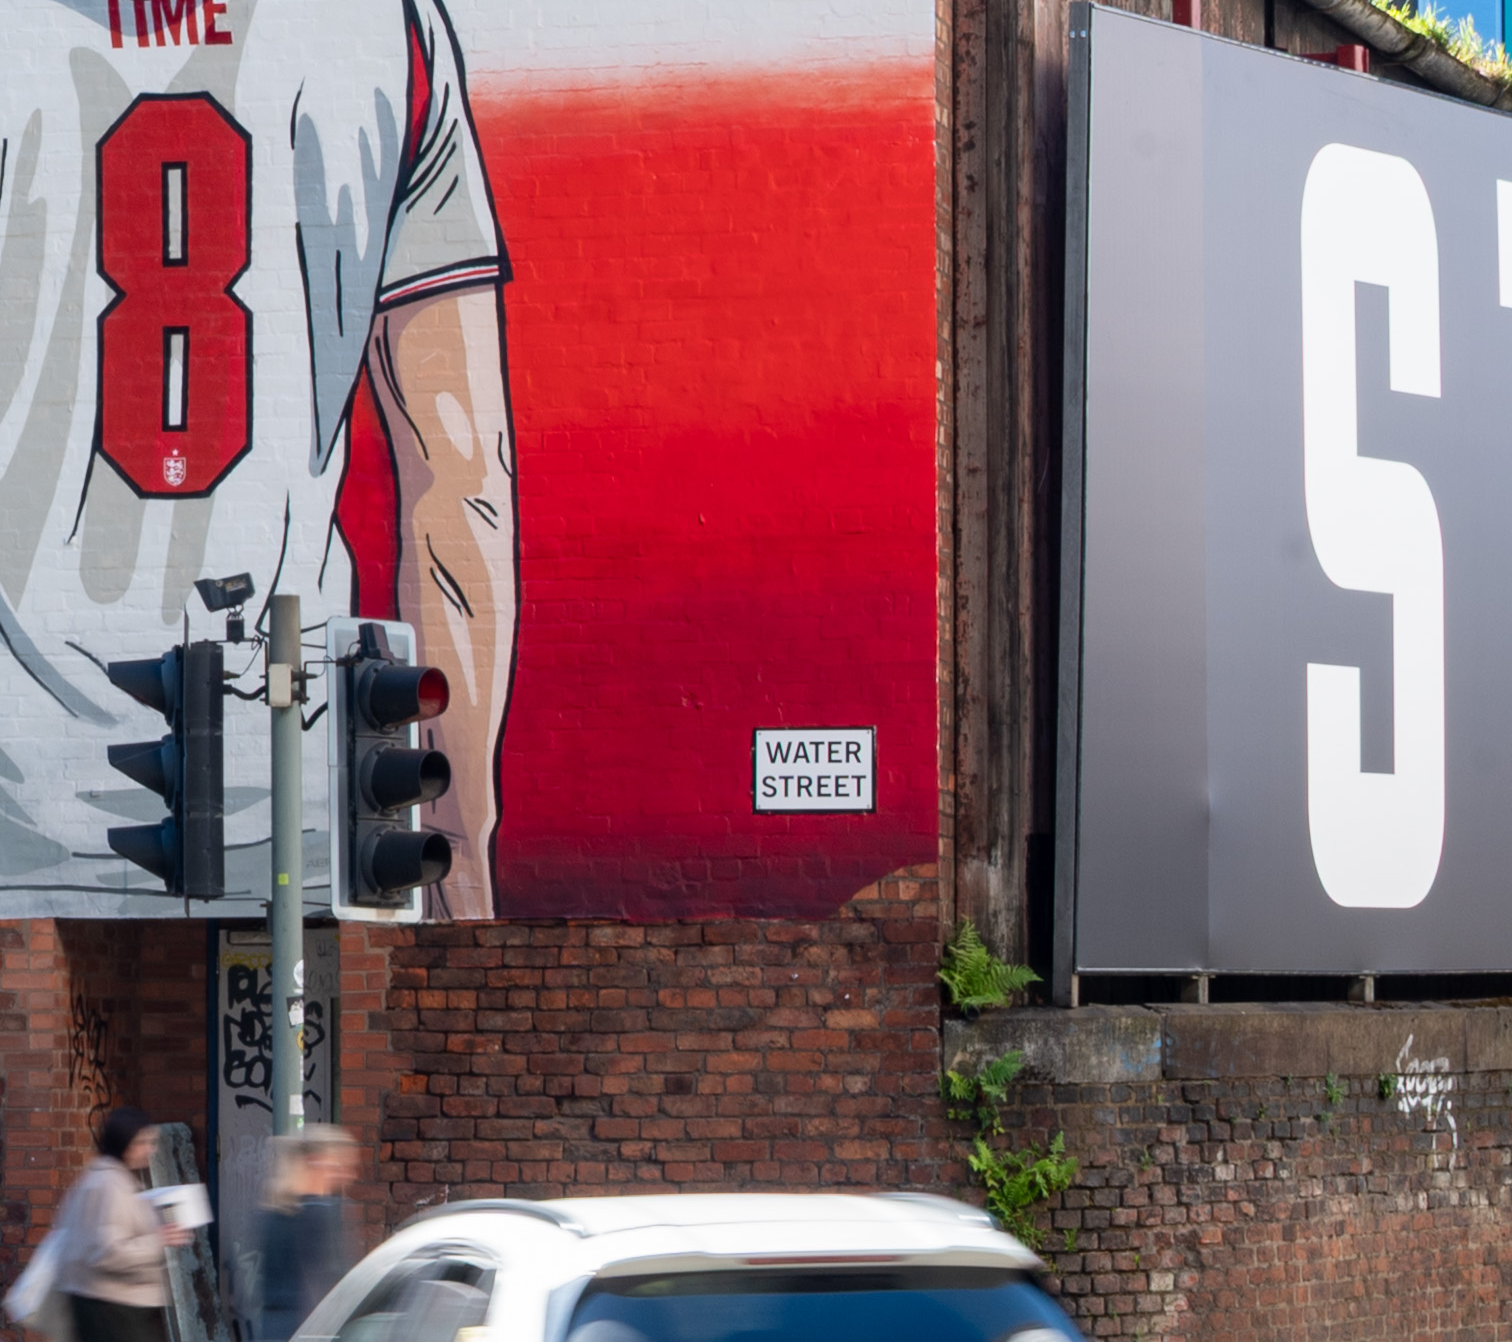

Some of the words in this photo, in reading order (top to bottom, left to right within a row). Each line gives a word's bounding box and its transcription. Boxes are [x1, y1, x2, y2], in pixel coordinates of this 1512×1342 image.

[93, 90, 256, 497] 8
[765, 741, 862, 764] WATER
[761, 775, 867, 798] STREET
